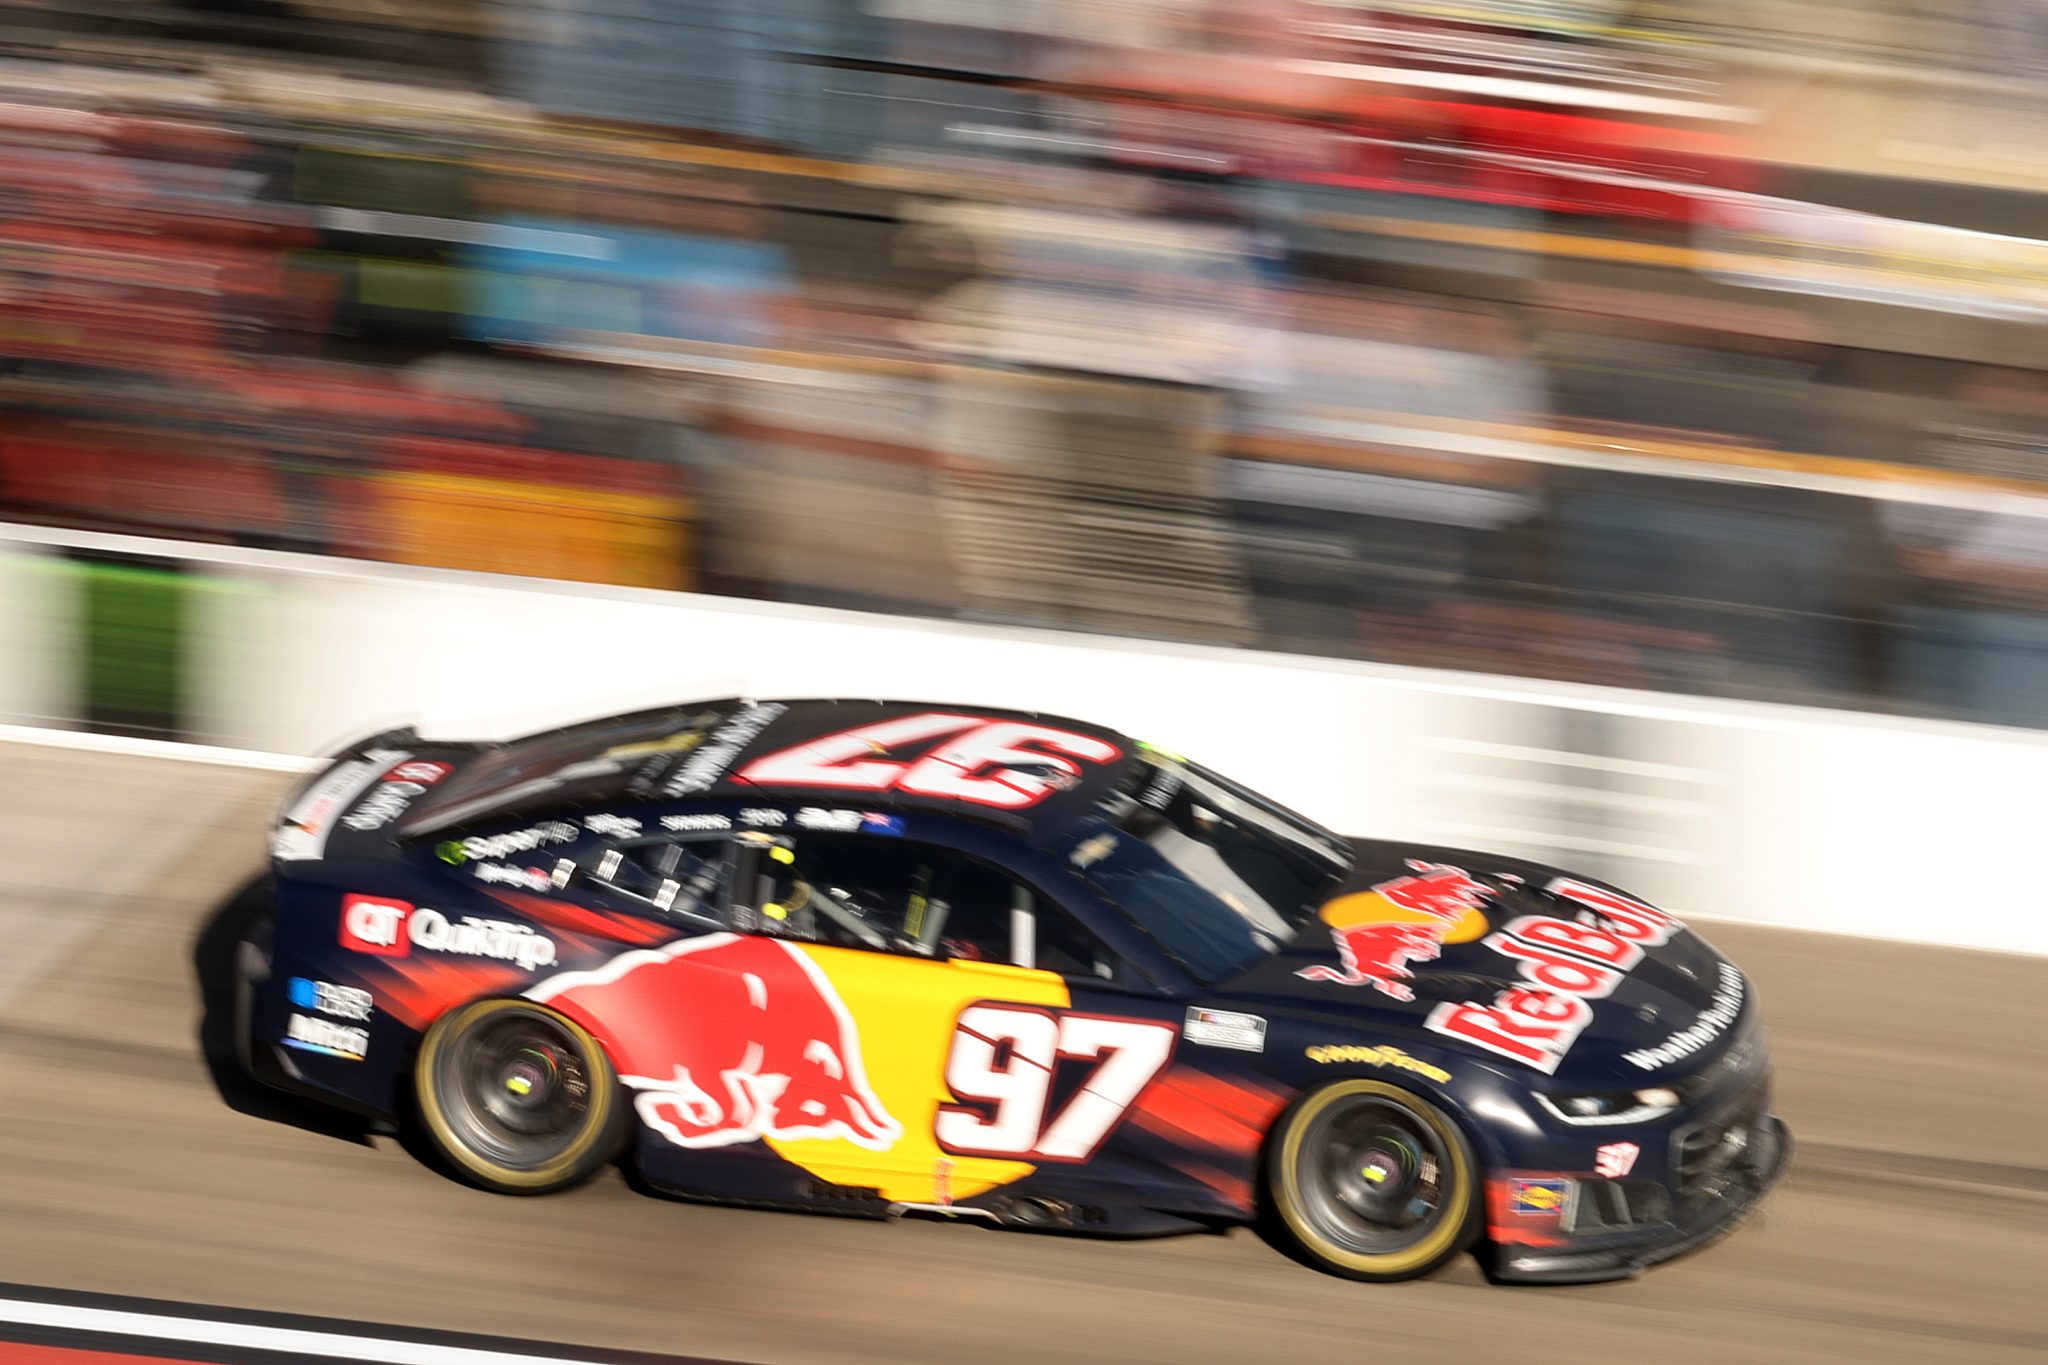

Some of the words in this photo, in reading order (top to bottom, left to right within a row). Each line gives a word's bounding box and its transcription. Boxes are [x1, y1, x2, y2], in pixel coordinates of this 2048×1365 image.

[345, 901, 406, 947] QT
[934, 1001, 1179, 1163] 97
[1593, 1140, 1641, 1179] 97
